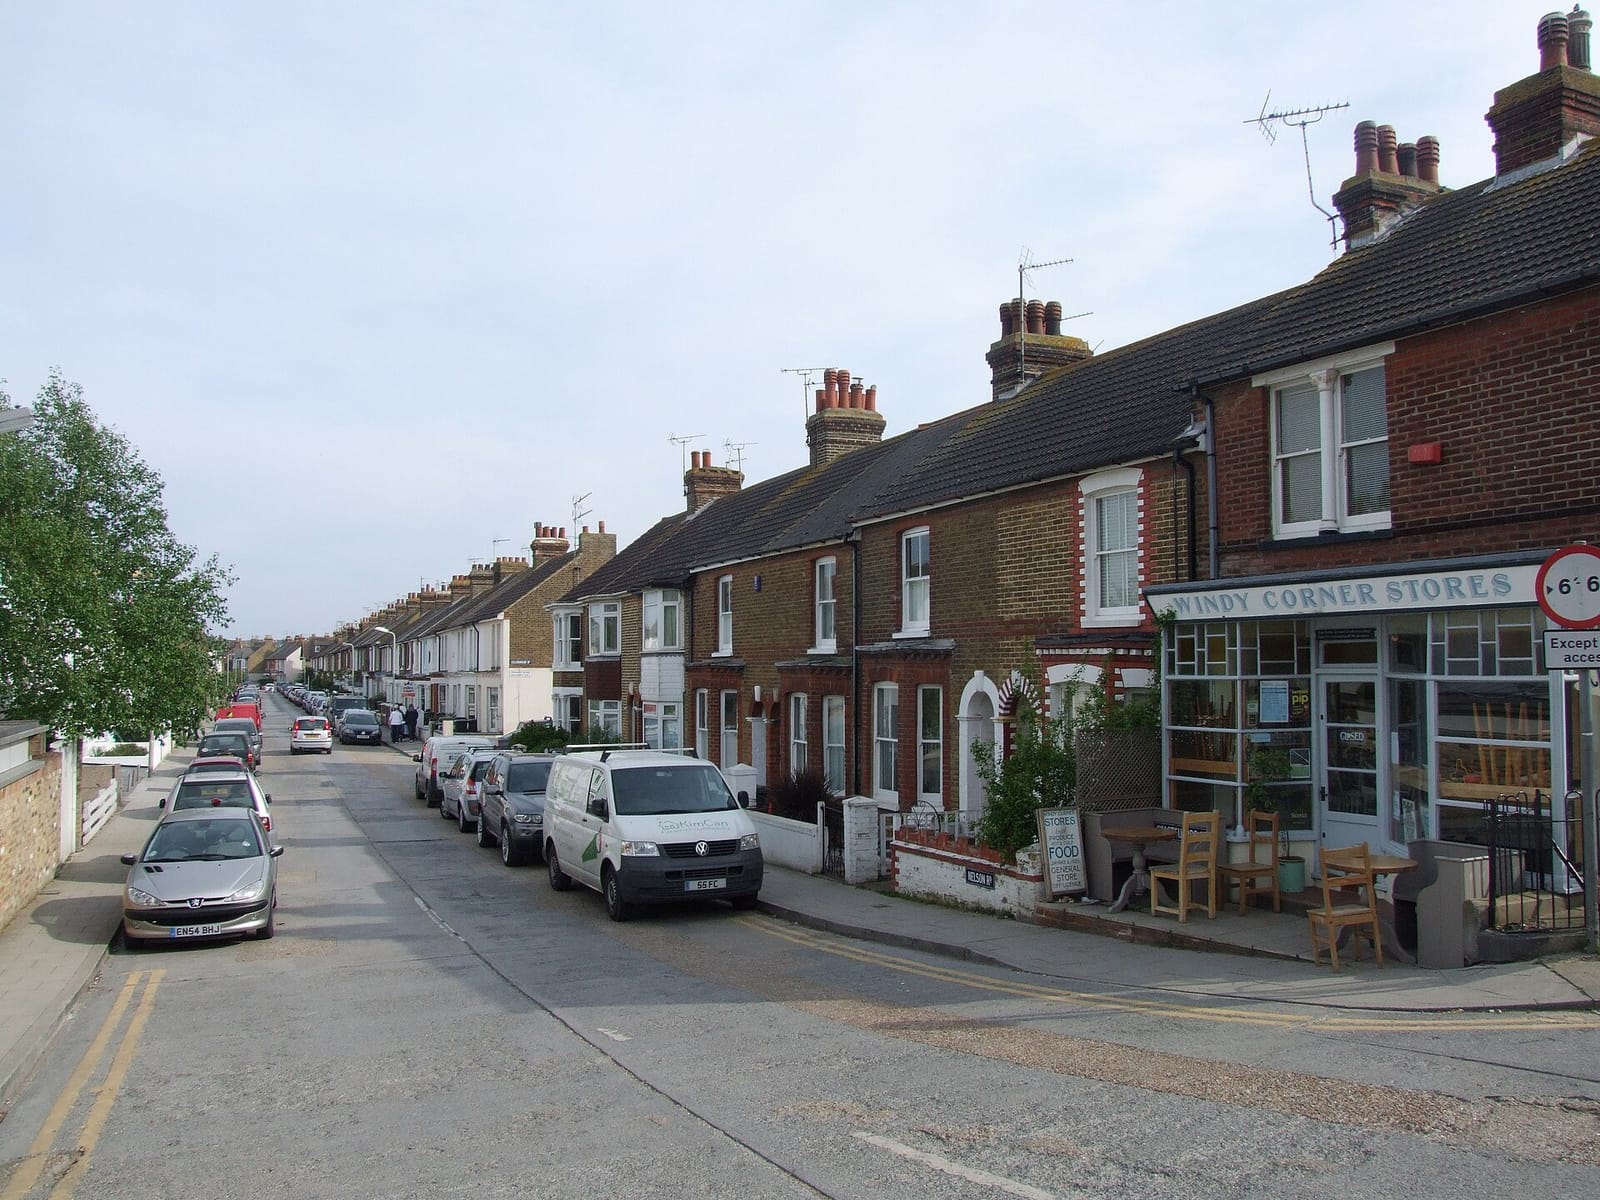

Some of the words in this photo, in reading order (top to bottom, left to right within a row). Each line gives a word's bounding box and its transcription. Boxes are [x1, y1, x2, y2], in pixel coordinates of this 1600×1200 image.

[1173, 592, 1248, 614] WINDY
[1262, 583, 1377, 610] CORNER
[1386, 573, 1512, 602] STORES
[1551, 637, 1598, 650] Except
[1340, 731, 1364, 741] CLOSED
[1044, 817, 1076, 827] STORES
[1049, 846, 1079, 859] FOOD
[1051, 865, 1080, 874] GENERAL
[967, 871, 985, 885] NELSON
[1056, 873, 1078, 881] STORE
[708, 880, 719, 888] FC
[176, 927, 200, 936] EN54
[202, 925, 220, 935] BHJ
